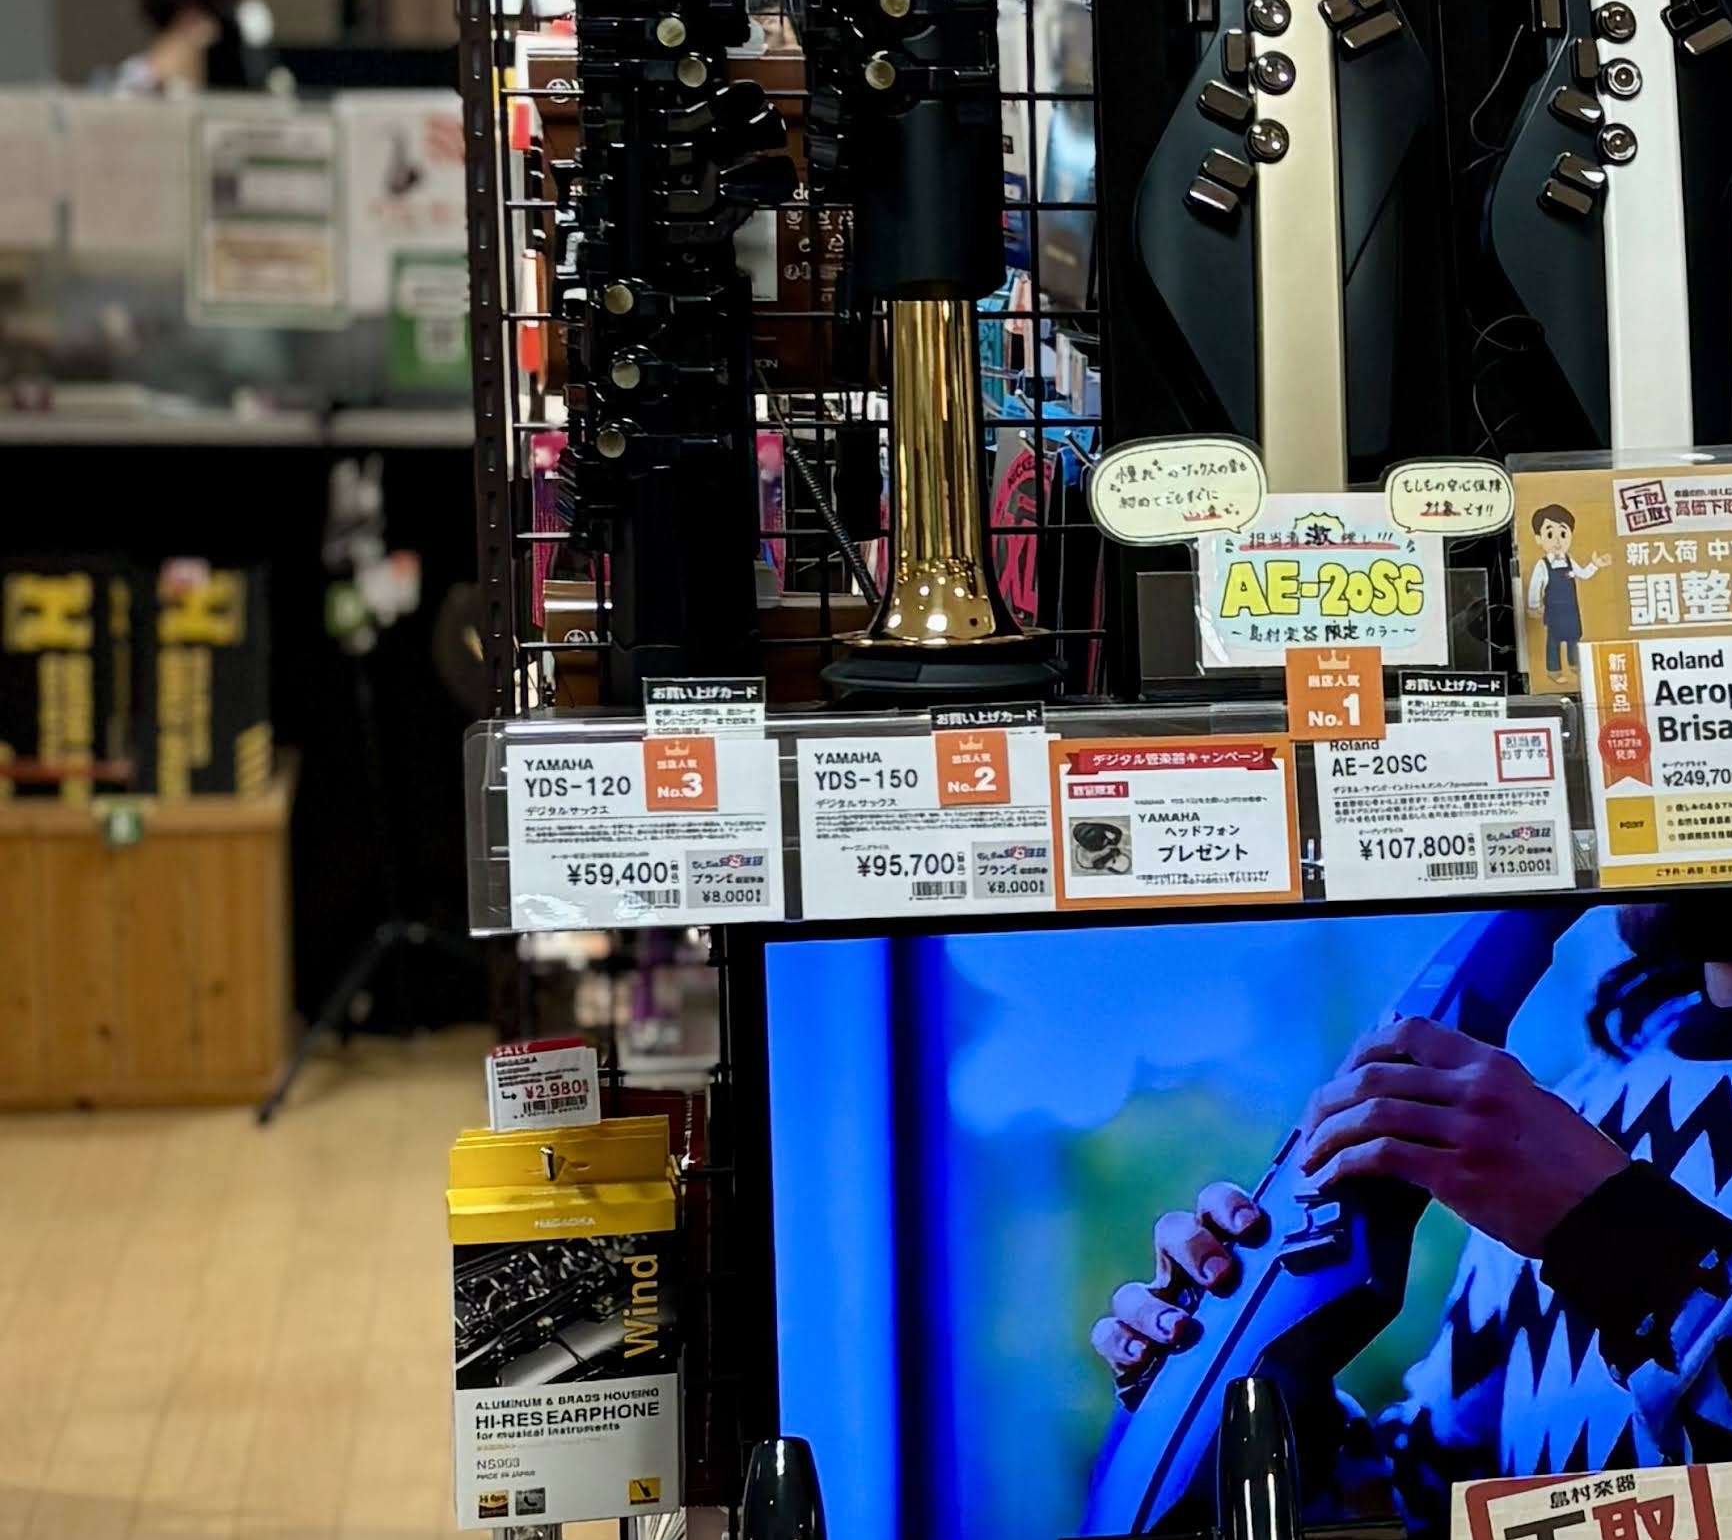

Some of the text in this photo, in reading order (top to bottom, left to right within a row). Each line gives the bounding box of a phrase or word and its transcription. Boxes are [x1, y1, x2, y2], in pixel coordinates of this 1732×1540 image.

[1626, 540, 1698, 566] 新入荷
[1220, 558, 1424, 617] AE-20SC
[1652, 650, 1724, 671] Roland
[1308, 675, 1360, 687] 当店人気
[1405, 678, 1501, 692] お買い上げカード
[1608, 653, 1631, 712] 新製品
[936, 710, 1037, 724] お買い上げカード
[1330, 740, 1380, 751] Roland
[524, 759, 593, 771] YAMAHA
[814, 752, 882, 765] YAMAHA
[1093, 751, 1265, 766] デジタル管楽器キャンペーン
[1332, 754, 1427, 777] AE-20SC
[525, 776, 631, 798] YDS-120
[815, 769, 918, 790] YDS-150
[1138, 812, 1200, 823] YAMAHA
[1165, 825, 1240, 837] ヘッドフォン
[1158, 844, 1248, 863] プレゼント
[1359, 835, 1466, 861] ¥107,800
[567, 862, 668, 886] ¥59,400
[857, 853, 955, 877] ¥95,700
[624, 1254, 658, 1359] Wind
[476, 1397, 542, 1410] ALUMINUM
[558, 1392, 600, 1405] BRASS
[604, 1388, 659, 1401] HOUSING
[476, 1402, 659, 1429] HI-RES EARPHONE
[477, 1423, 620, 1440] for musical instruments
[1550, 1473, 1637, 1509] 島村楽器
